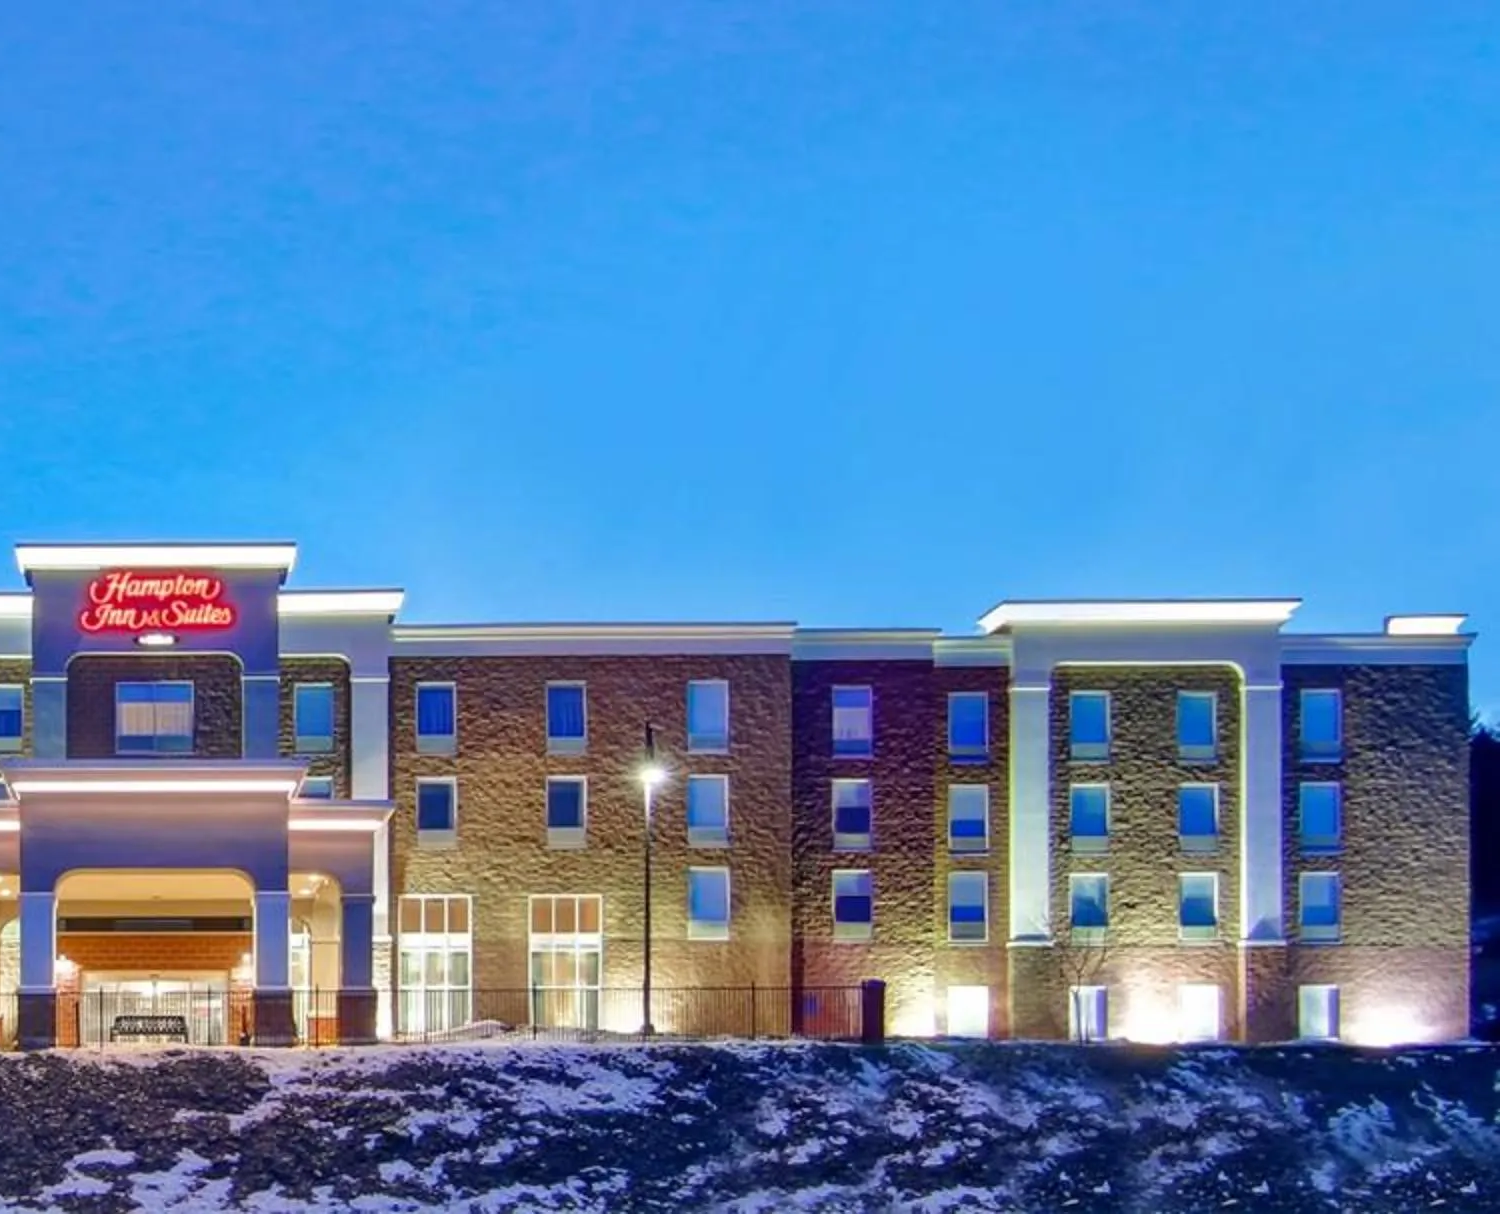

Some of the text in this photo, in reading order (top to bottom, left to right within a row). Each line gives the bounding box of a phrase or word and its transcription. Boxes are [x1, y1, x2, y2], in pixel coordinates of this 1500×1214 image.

[90, 572, 221, 603] Hampton
[81, 601, 232, 630] Inn & Suites
